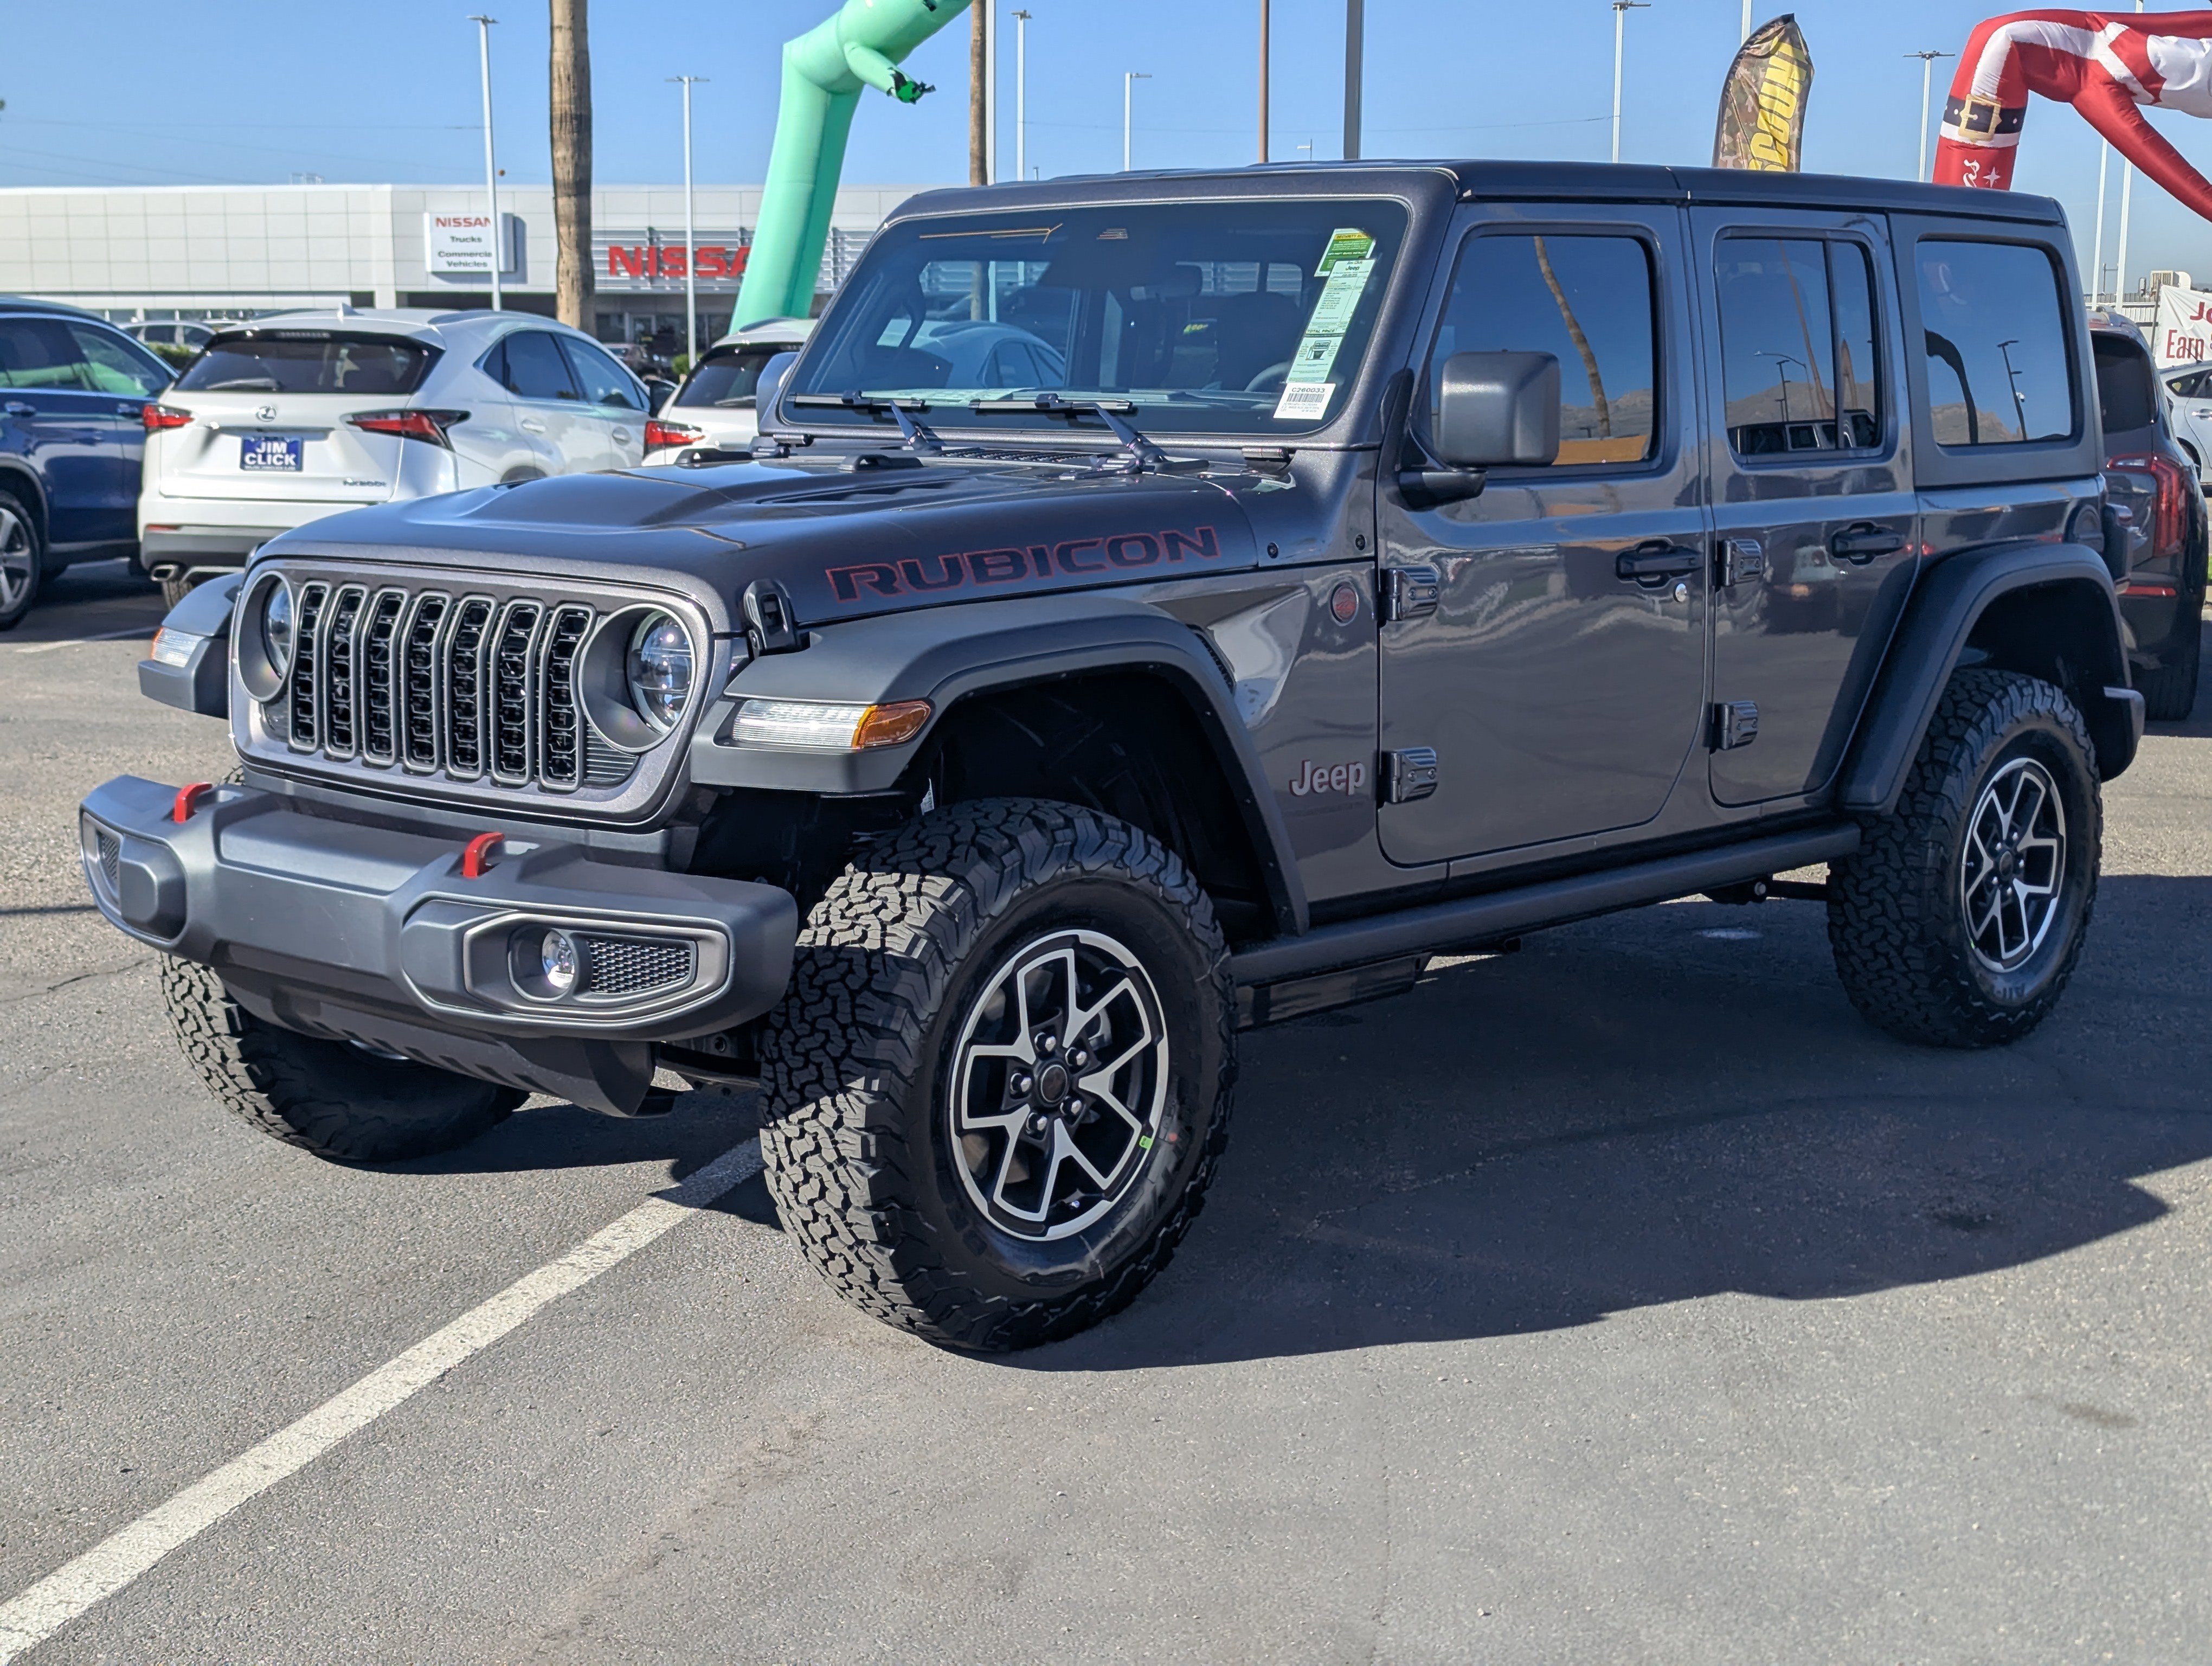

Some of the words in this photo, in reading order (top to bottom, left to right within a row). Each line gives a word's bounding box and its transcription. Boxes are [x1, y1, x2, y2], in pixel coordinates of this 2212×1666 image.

[608, 246, 751, 277] NISS
[2166, 329, 2204, 361] Earn
[245, 453, 296, 465] CLICK
[256, 441, 287, 453] JIM
[826, 526, 1220, 603] RUBICON
[1289, 759, 1366, 797] Jeep
